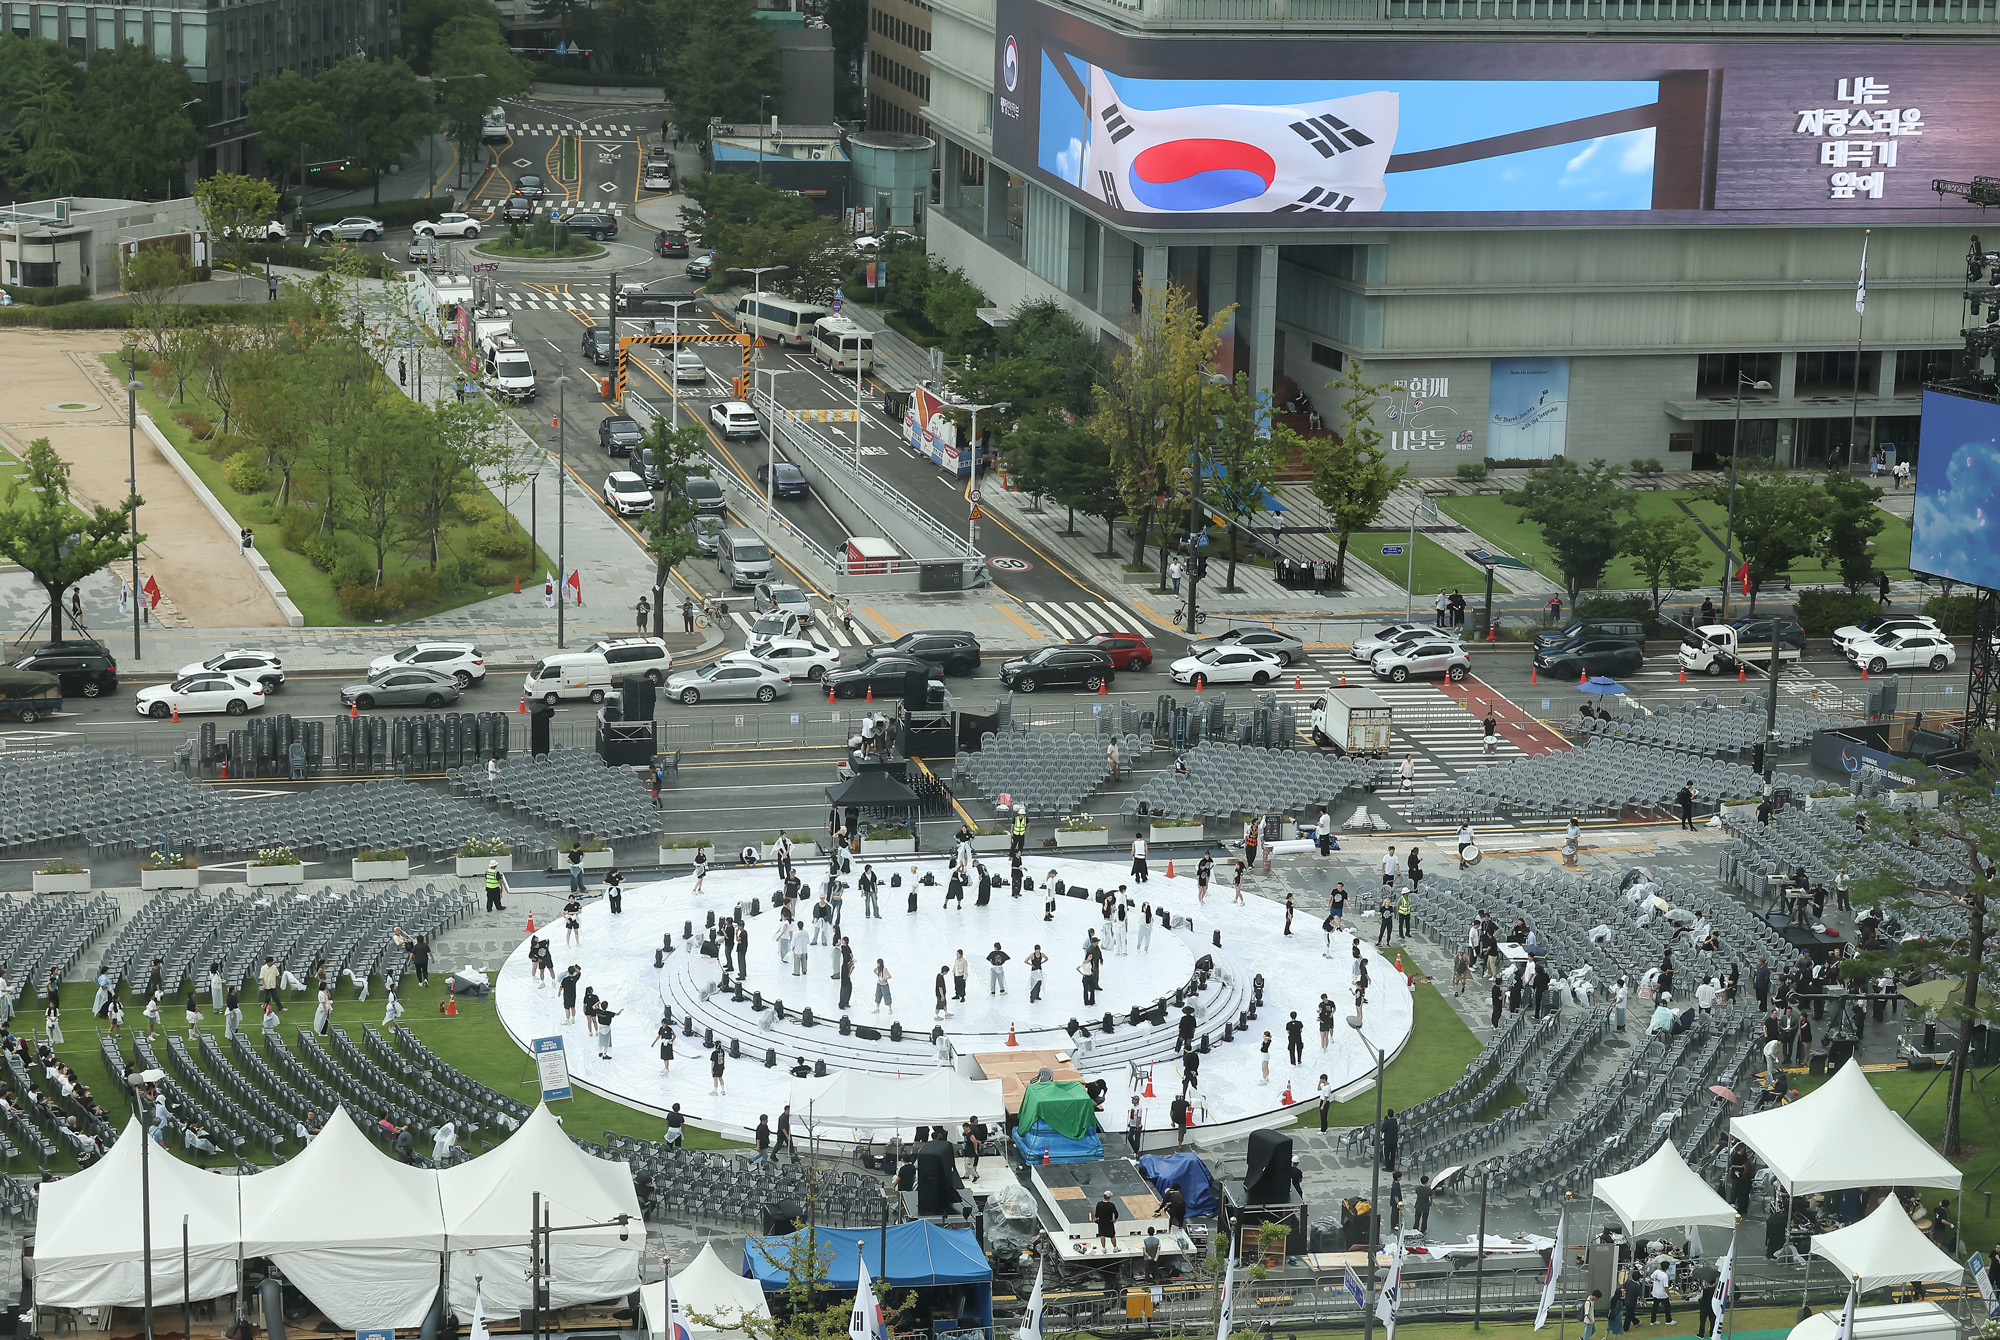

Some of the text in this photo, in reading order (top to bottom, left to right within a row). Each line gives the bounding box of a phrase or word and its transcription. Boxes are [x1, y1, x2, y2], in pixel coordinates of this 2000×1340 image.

[1836, 76, 1891, 105] 나는
[1796, 107, 1925, 137] 자랑스러운
[1820, 140, 1898, 168] 태극기
[1830, 171, 1885, 199] 앞에
[1409, 377, 1449, 399] 함께
[1502, 415, 1518, 423] Shared
[1519, 406, 1536, 420] Journey
[995, 559, 1025, 569] 30
